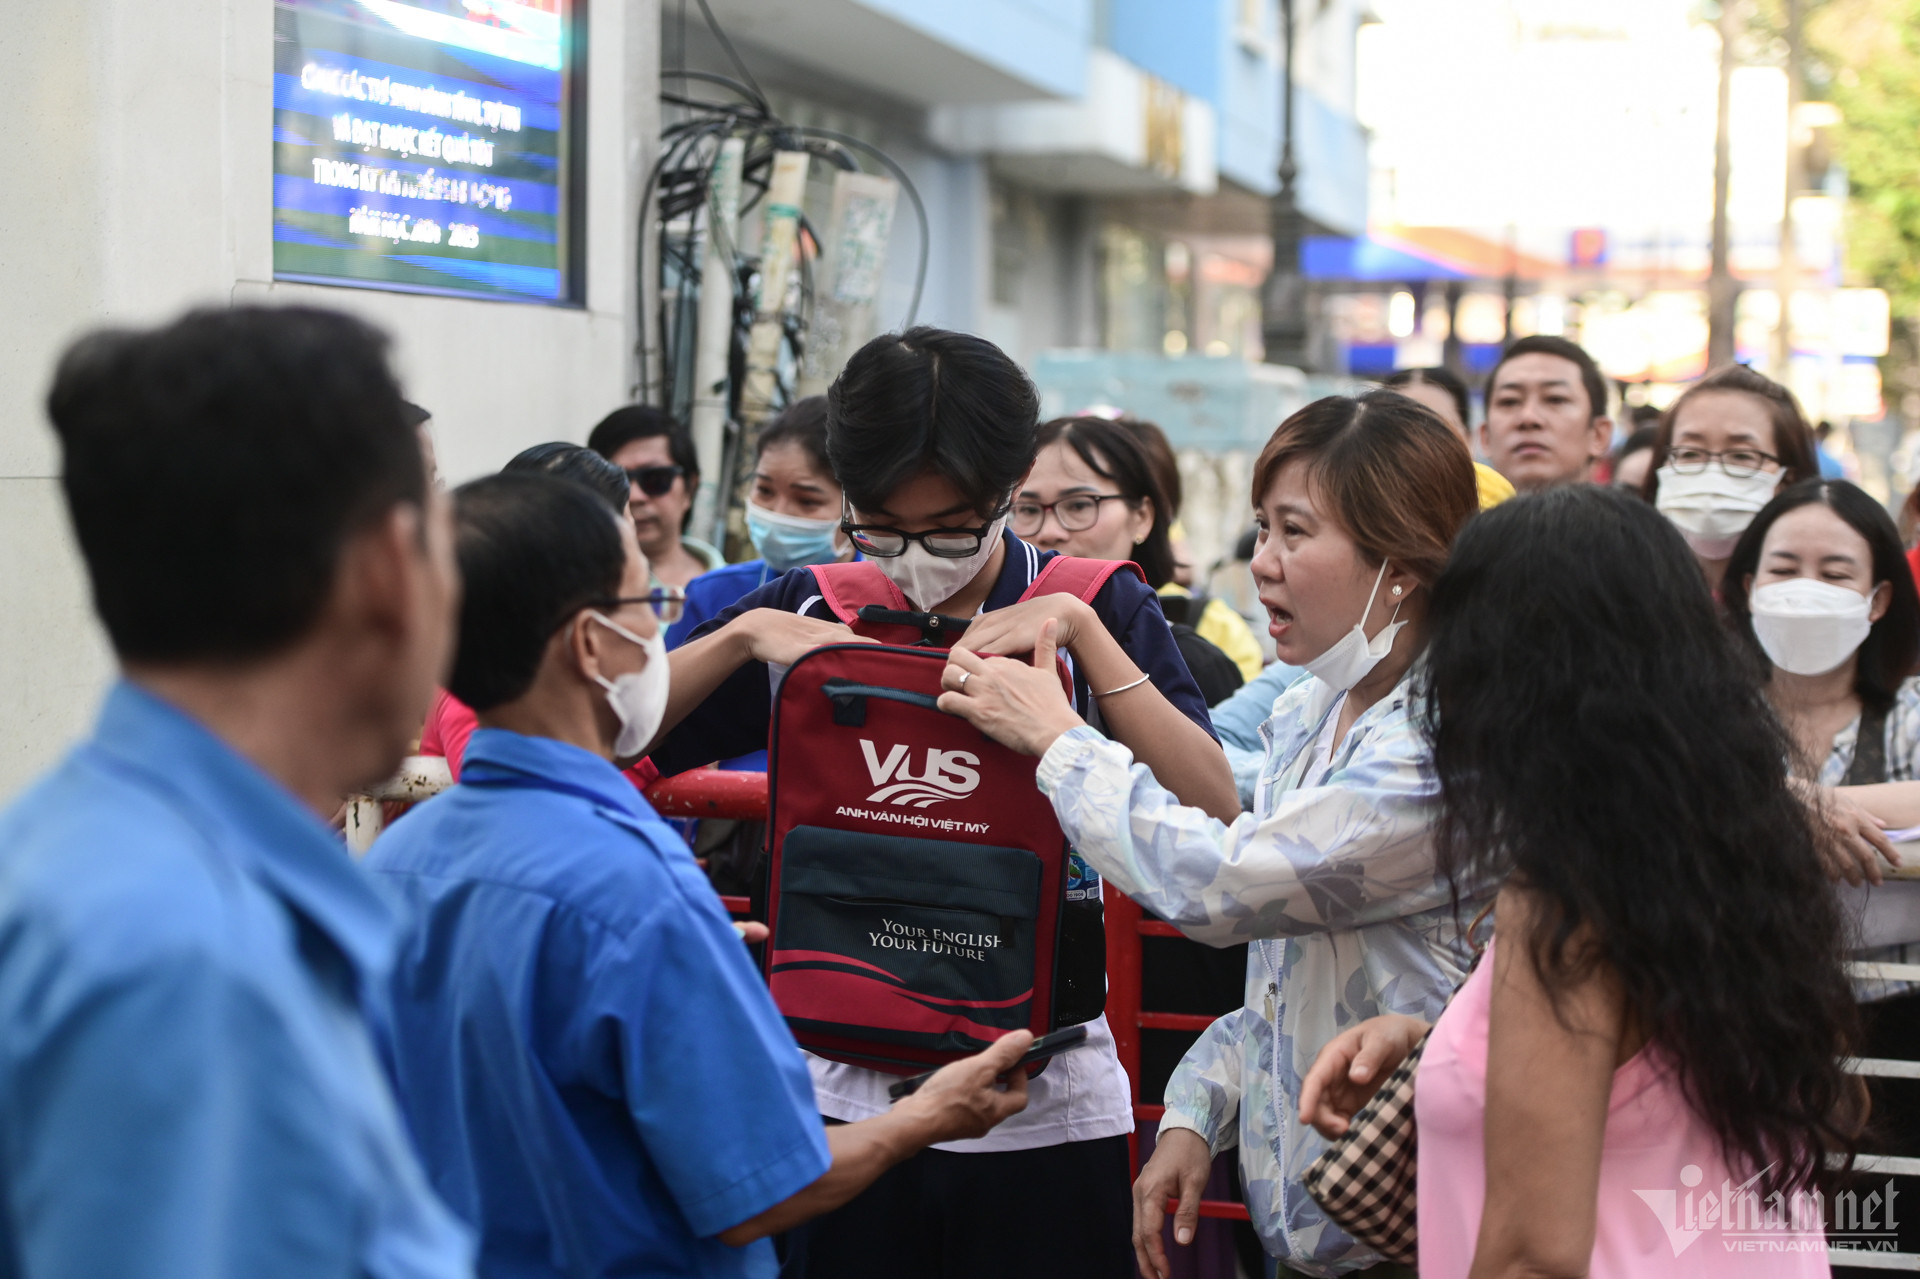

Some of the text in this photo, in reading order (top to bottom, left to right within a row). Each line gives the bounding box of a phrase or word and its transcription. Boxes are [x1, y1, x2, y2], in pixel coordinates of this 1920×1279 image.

[858, 738, 982, 794] VUS
[835, 805, 990, 834] ANH VĂN HỘI VIỆT MỸ
[882, 918, 929, 938] YOUR
[869, 932, 986, 962] YOUR FUTURE
